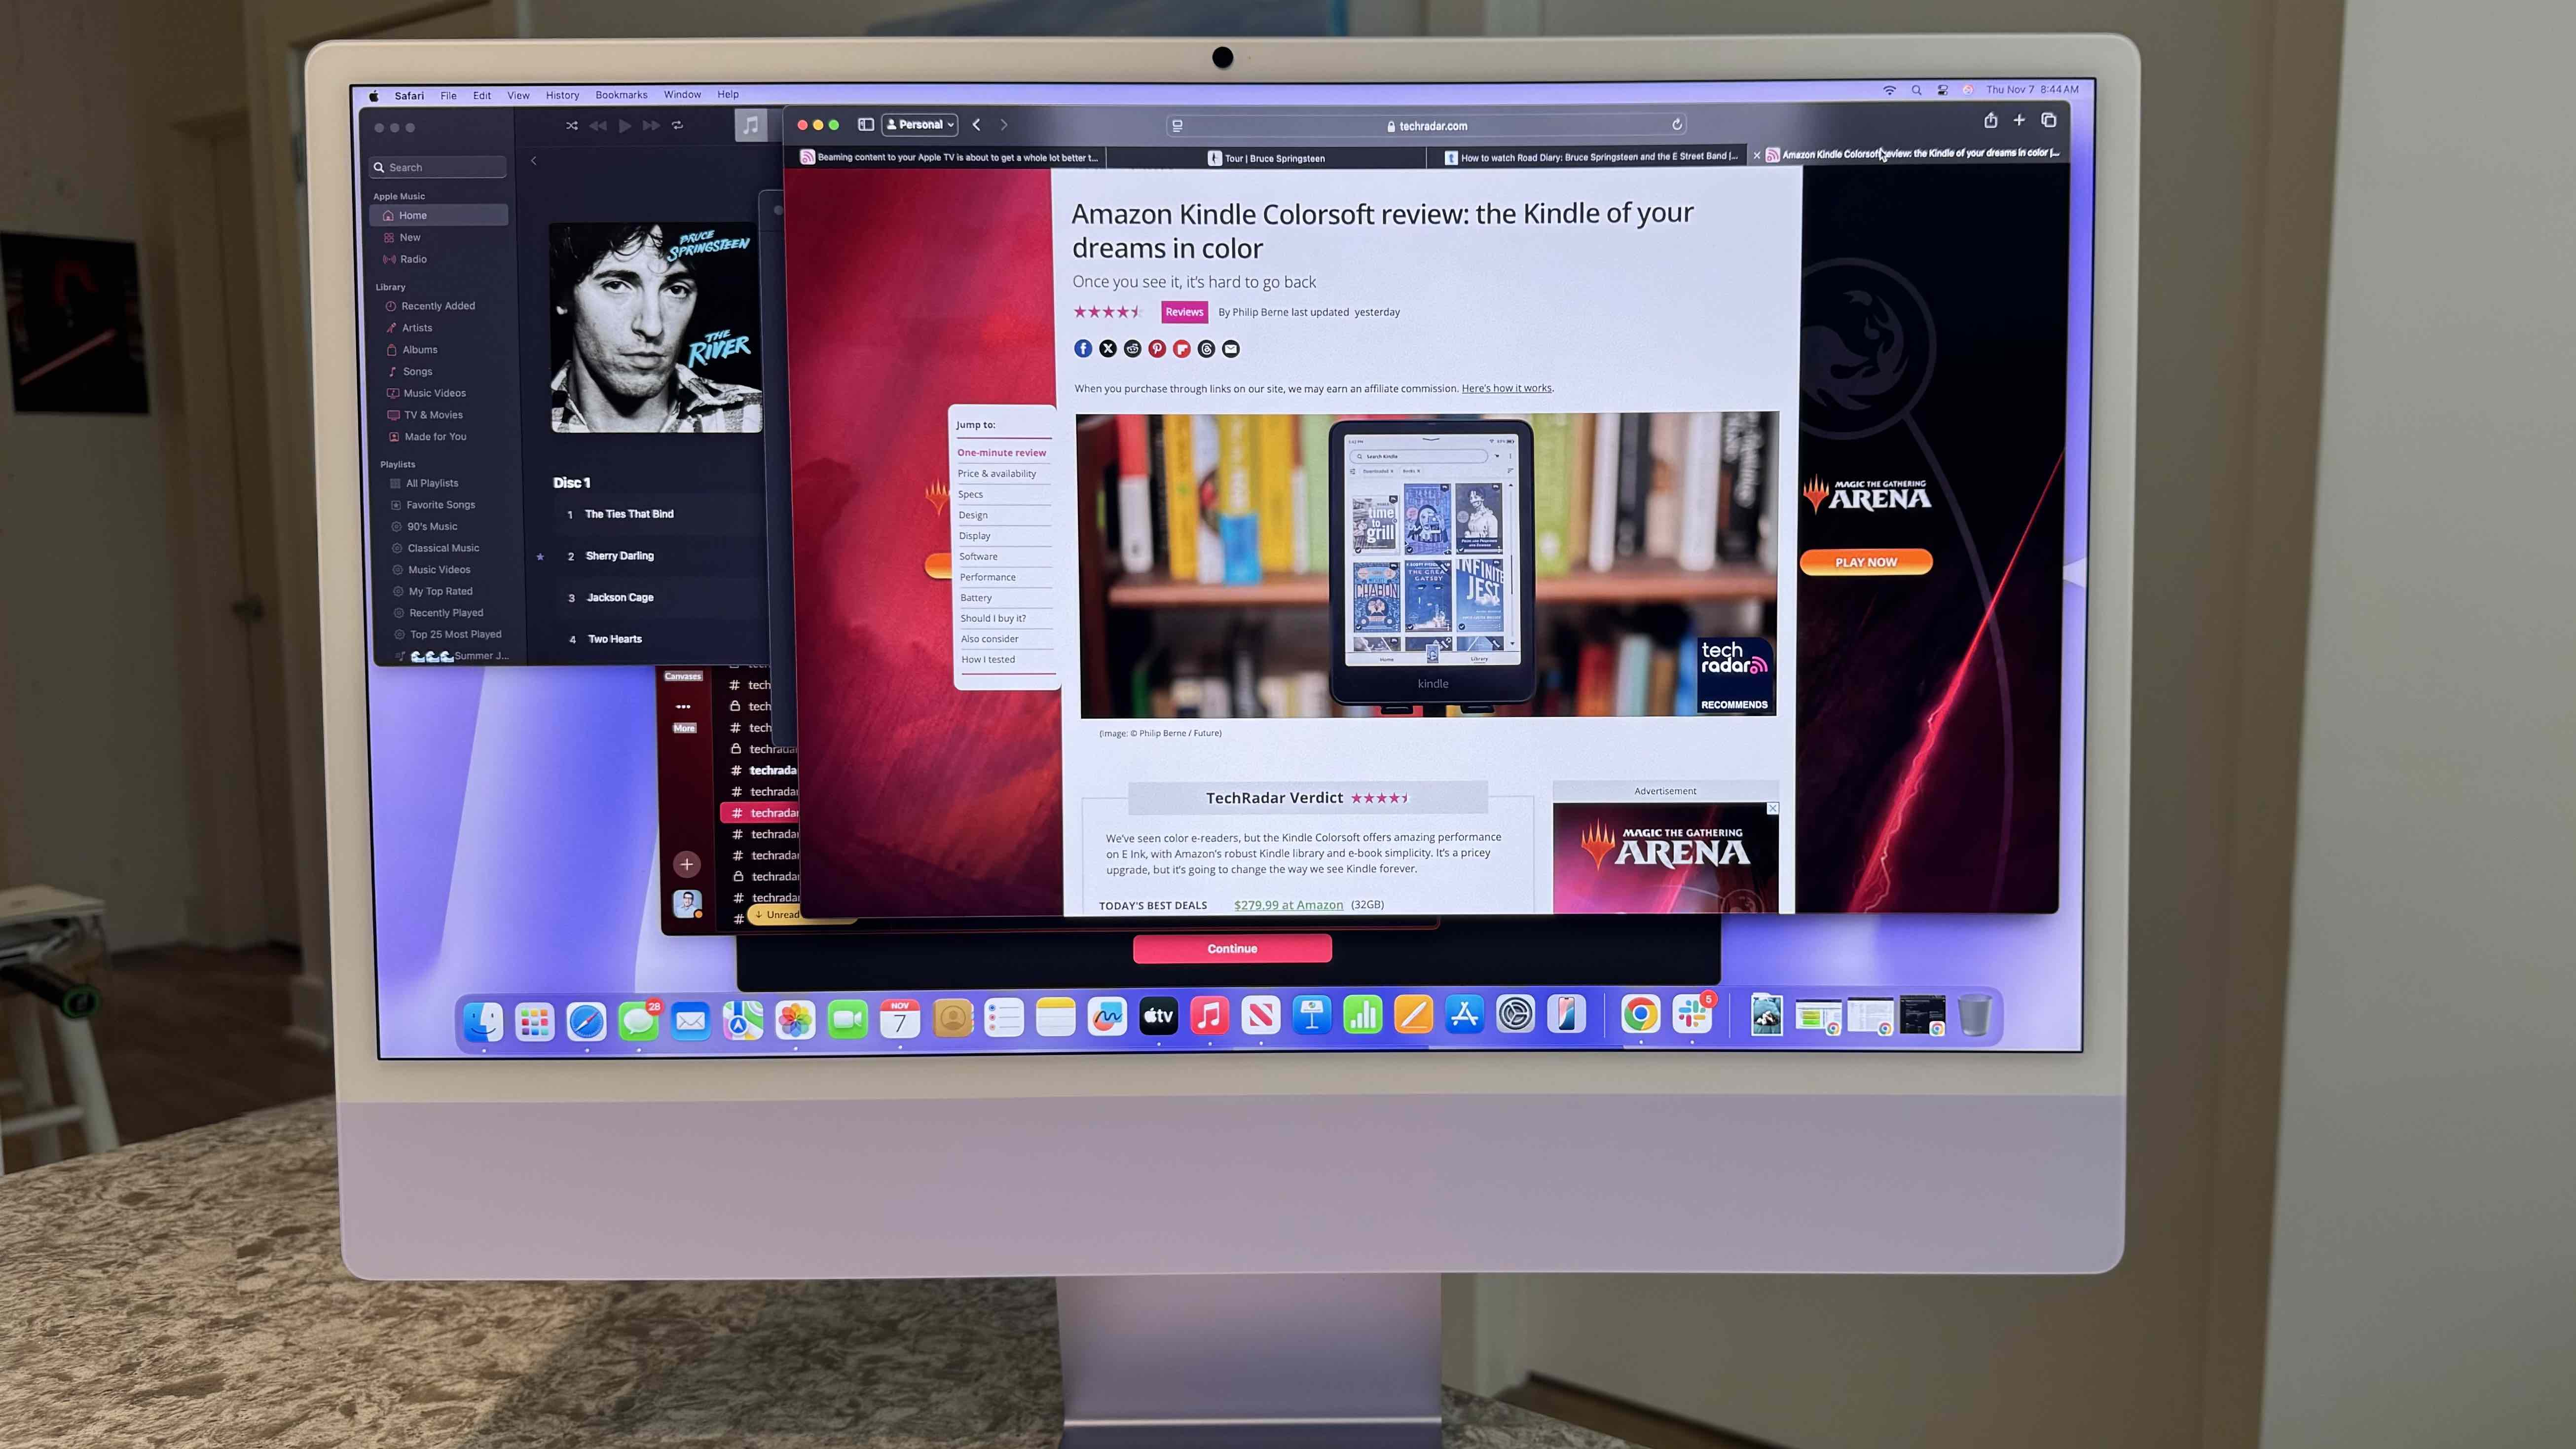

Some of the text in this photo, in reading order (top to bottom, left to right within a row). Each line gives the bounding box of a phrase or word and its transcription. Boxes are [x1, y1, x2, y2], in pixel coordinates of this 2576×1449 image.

[596, 90, 648, 99] Bookmarks
[664, 90, 701, 99] Window
[1987, 85, 2079, 94] Thu Nov 7 8:44 AM
[395, 91, 424, 100] Safari
[441, 91, 457, 100] File
[474, 91, 491, 100] Edit
[507, 91, 530, 100] View
[546, 91, 580, 101] History
[718, 90, 739, 100] Help
[899, 119, 944, 130] Personal
[1399, 120, 1469, 131] techradar.com
[1250, 154, 1274, 163] Bruce
[1276, 154, 1325, 164] Springsteen
[389, 163, 422, 172] Search
[373, 192, 425, 202] Apple Music
[400, 211, 427, 220] Home
[1071, 201, 1694, 229] Amazon Kindle Colorsoft review: the Kindle of your
[400, 233, 421, 241] New
[680, 229, 715, 245] BRUCE
[666, 237, 751, 262] SPRINGSTEEN
[1073, 236, 1264, 259] dreams in color
[401, 255, 427, 263] Radio
[376, 283, 406, 293] Library
[1073, 275, 1317, 292] Once you see it, it's hard to go back
[402, 301, 476, 312] Recently Added
[1166, 307, 1204, 317] Reviews
[1219, 307, 1400, 319] By Philip Berne last updated yesterday
[402, 323, 433, 332] Artists
[704, 329, 732, 343] THE
[403, 345, 438, 354] Albums
[688, 335, 751, 369] RIVER
[404, 367, 433, 377] Songs
[404, 388, 466, 398] Music Videos
[956, 421, 981, 431] Jump
[957, 448, 1047, 457] One-minute review
[380, 460, 416, 470] Playlists
[958, 469, 1036, 480] Price & availability
[406, 479, 459, 489] All Playlists
[553, 476, 590, 488] Disc 1
[958, 490, 983, 500] Specs
[407, 500, 476, 511] Favorite Songs
[1829, 489, 1932, 512] ARENA
[568, 511, 573, 519] 1
[585, 509, 674, 519] The Ties That Bind
[959, 511, 988, 521] Design
[1368, 507, 1395, 519] time
[407, 522, 458, 531] 90's Music
[1371, 518, 1381, 527] to
[959, 531, 991, 542] Display
[1367, 524, 1394, 543] grill
[568, 552, 575, 561] 2
[586, 551, 654, 562] Sherry Darling
[959, 552, 998, 560] Software
[1835, 557, 1898, 568] PLAY NOW
[960, 573, 1016, 581] Performance
[1467, 575, 1500, 601] JEST
[960, 594, 992, 604] Battery
[410, 630, 502, 640] Top 25 Most Played
[569, 635, 576, 644] 4
[588, 634, 643, 643] Two Hearts
[1702, 641, 1743, 657] tech
[1702, 657, 1751, 672] radar
[665, 671, 701, 681] Canvases
[1418, 679, 1449, 689] kindle
[1702, 701, 1768, 709] RECOMMENDS
[673, 723, 695, 733] More
[1634, 787, 1697, 795] Advertisement
[1206, 791, 1344, 804] TechRadar Verdict
[1106, 834, 1135, 843] We've
[1164, 833, 1189, 843] color
[1191, 833, 1241, 844] e-readers,
[1244, 833, 1261, 842] but
[1263, 833, 1279, 842] the
[1282, 832, 1313, 842] Kindle
[1315, 832, 1360, 842] Colorsoft
[1363, 832, 1392, 842] offers
[1394, 832, 1435, 844] amazing
[1438, 832, 1502, 844] performance
[1622, 828, 1743, 838] MAGIC THE GATHERING
[1615, 840, 1751, 870] ARENA
[1099, 901, 1207, 910] TODAY'S BEST DEALS
[1234, 900, 1384, 911] $279.99 at Amazon (32GB)
[767, 909, 799, 919] Unread
[1208, 943, 1258, 954] Continue
[1706, 995, 1712, 1003] 5
[1157, 1009, 1174, 1023] tv
[894, 1014, 906, 1033] 7
